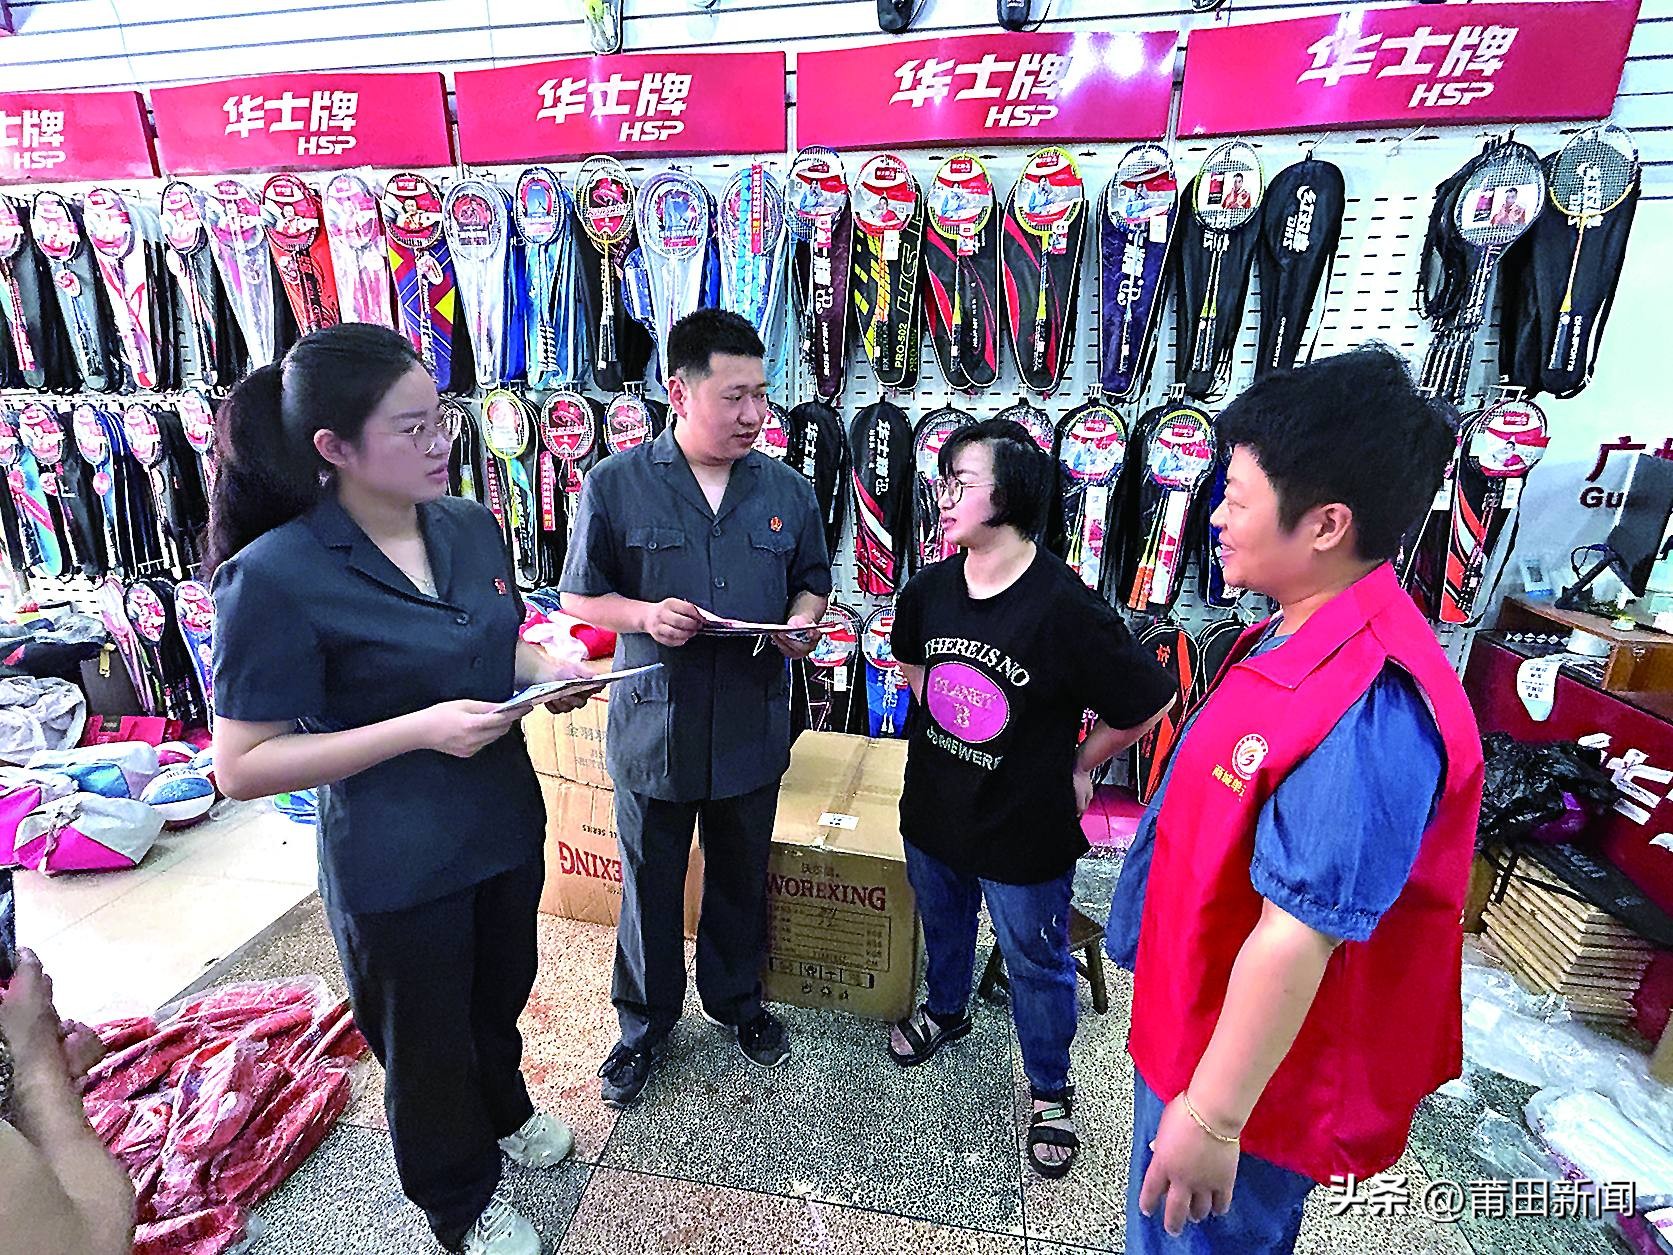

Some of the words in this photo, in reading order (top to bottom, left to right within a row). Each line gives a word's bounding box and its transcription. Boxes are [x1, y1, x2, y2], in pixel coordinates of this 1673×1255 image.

[1297, 25, 1519, 87] 华士牌
[536, 72, 693, 124] 华士牌
[889, 53, 1073, 108] 华士牌
[1408, 81, 1495, 108] HSP
[222, 90, 359, 138] 华士牌
[618, 120, 685, 142] HSP
[984, 105, 1059, 128] HSP
[14, 150, 67, 169] HSP
[298, 135, 357, 156] HSP
[1283, 214, 1298, 251] DHS
[894, 322, 907, 369] PRO-502
[976, 643, 1001, 668] IS
[996, 655, 1031, 687] NO
[933, 676, 999, 710] PLANET
